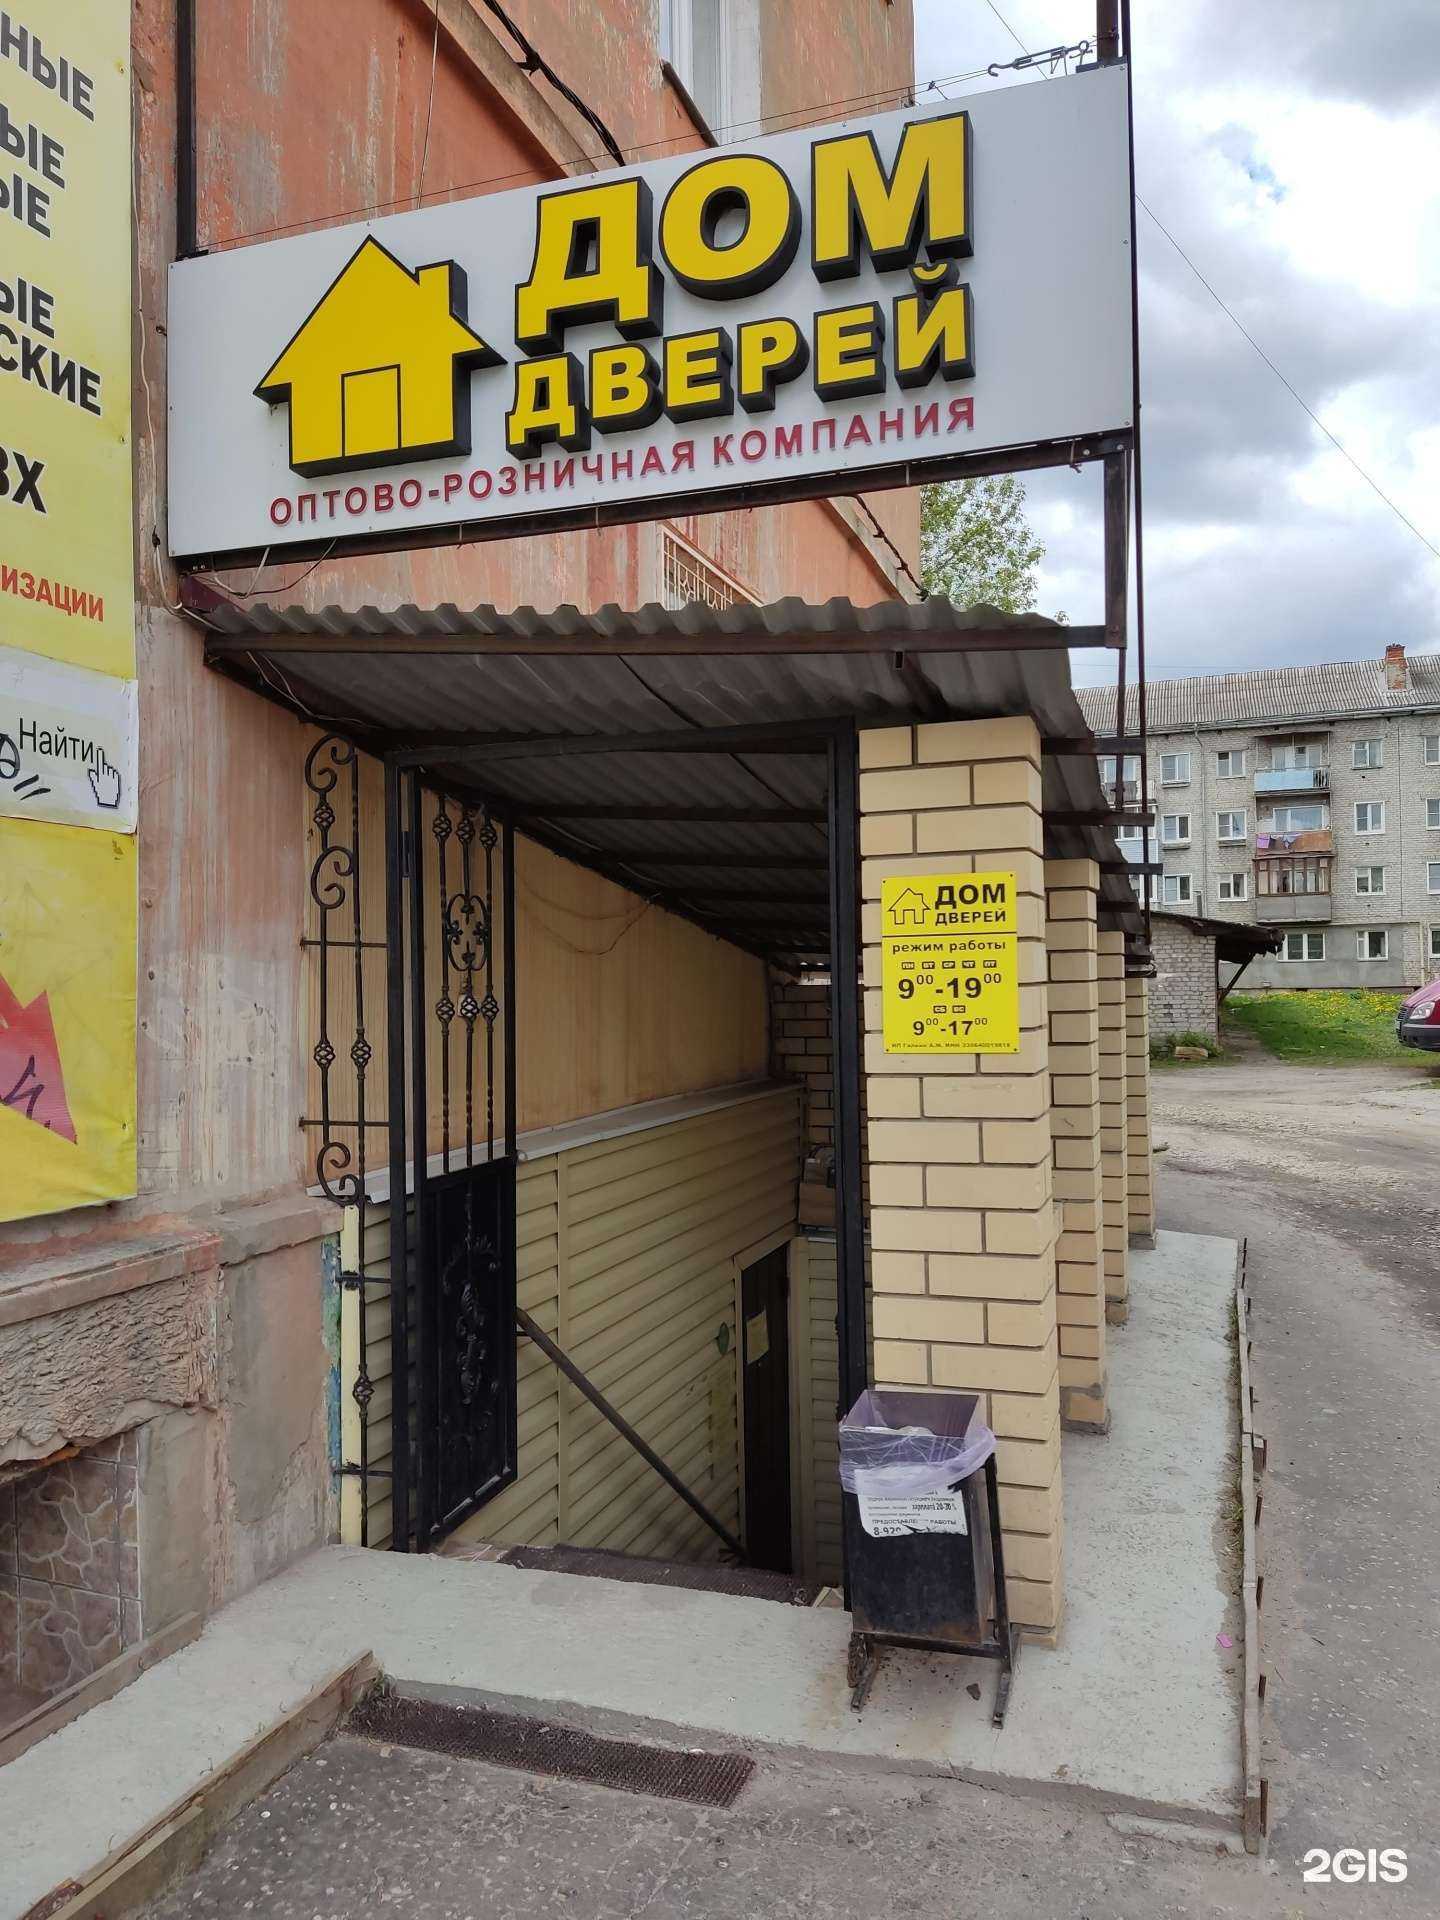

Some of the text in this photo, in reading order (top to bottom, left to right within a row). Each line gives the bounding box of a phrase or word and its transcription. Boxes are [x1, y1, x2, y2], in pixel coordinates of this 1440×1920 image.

[0, 11, 95, 122] НЫЕ
[515, 111, 975, 355] ДОМ
[505, 260, 976, 460] ДВЕРЕЙ
[269, 396, 975, 526] ОПТОВО-РОЗНИЧНАЯ КОМПАНИЯ
[0, 564, 105, 623] ИЗАЦИИ
[19, 716, 95, 764] Найти
[934, 883, 1006, 910] ДОМ
[934, 908, 1007, 927] ДВЕРЕЙ
[892, 940, 1006, 955] режим работы
